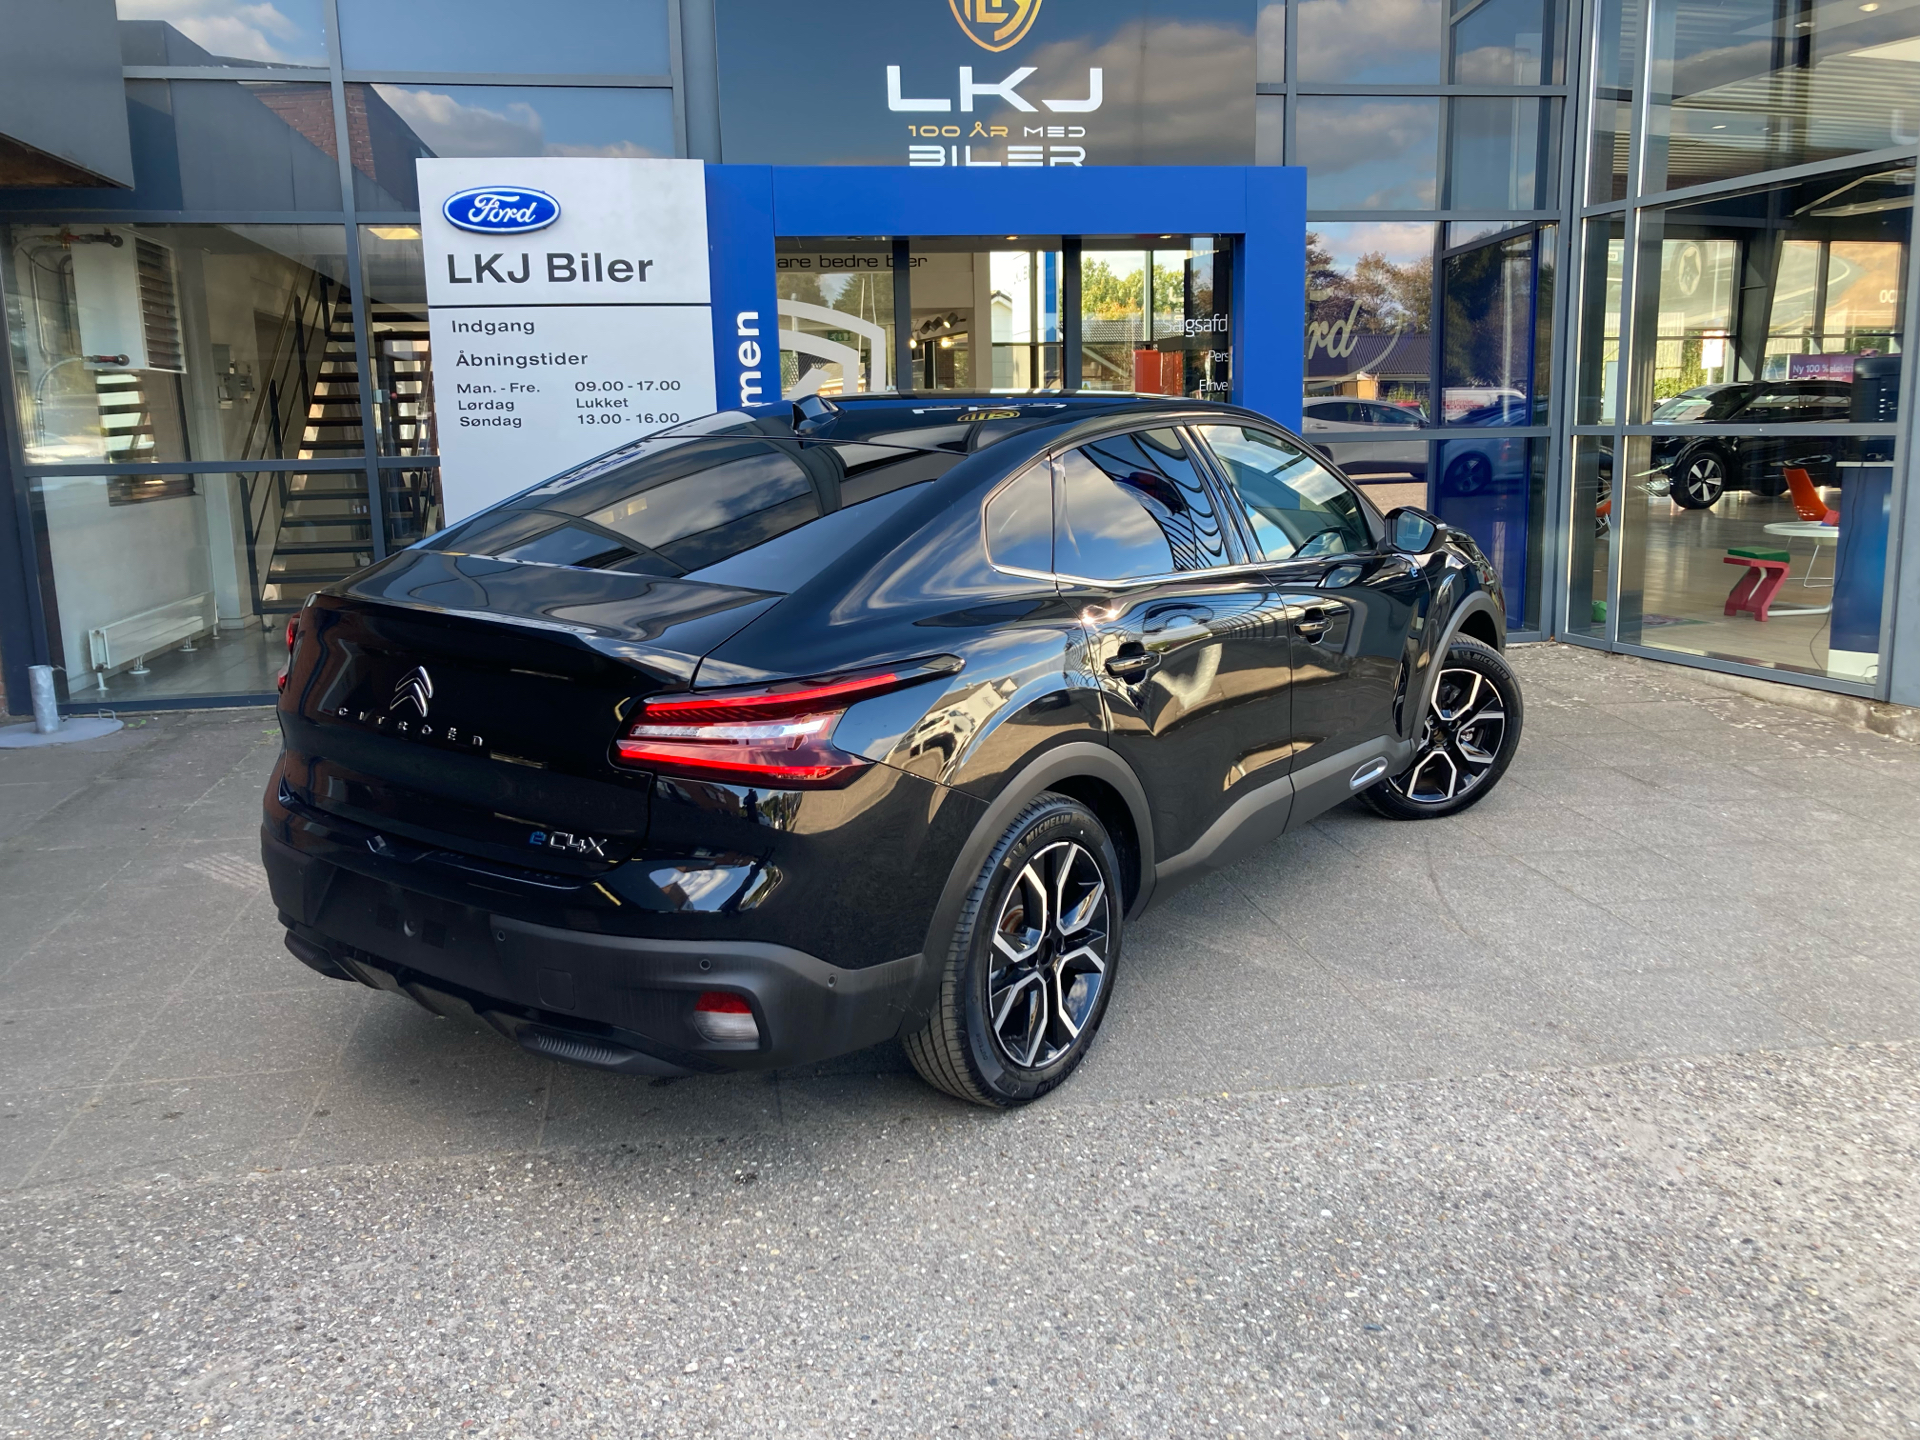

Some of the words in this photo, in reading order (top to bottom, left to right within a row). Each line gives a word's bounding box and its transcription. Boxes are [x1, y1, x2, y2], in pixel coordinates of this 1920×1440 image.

[887, 65, 1103, 112] LKJ
[908, 124, 961, 138] 100
[968, 121, 1009, 138] ÅR
[1023, 126, 1087, 138] MED
[909, 145, 1087, 167] BILER
[467, 193, 538, 224] Ford
[447, 253, 531, 284] LKJ
[547, 252, 654, 283] Biler
[819, 254, 879, 269] bedre
[886, 254, 928, 269] ber
[451, 319, 536, 336] Indgang
[1307, 298, 1363, 361] rd
[455, 350, 589, 368] Åbningstider
[736, 311, 763, 408] men
[1792, 364, 1805, 375] Ny
[1805, 364, 1820, 374] 100
[1821, 364, 1829, 374] %
[456, 382, 497, 394] Man.
[509, 382, 541, 394] Fre.
[574, 380, 625, 393] 09.00
[637, 380, 681, 392] 17.00
[457, 399, 516, 413] Lørdag
[576, 397, 629, 409] Lukket
[459, 415, 523, 429] Søndag
[577, 413, 622, 425] 13.00
[636, 412, 680, 424] 16.00
[1471, 652, 1510, 680] MICHELIN
[1025, 813, 1072, 845] MICHELIN
